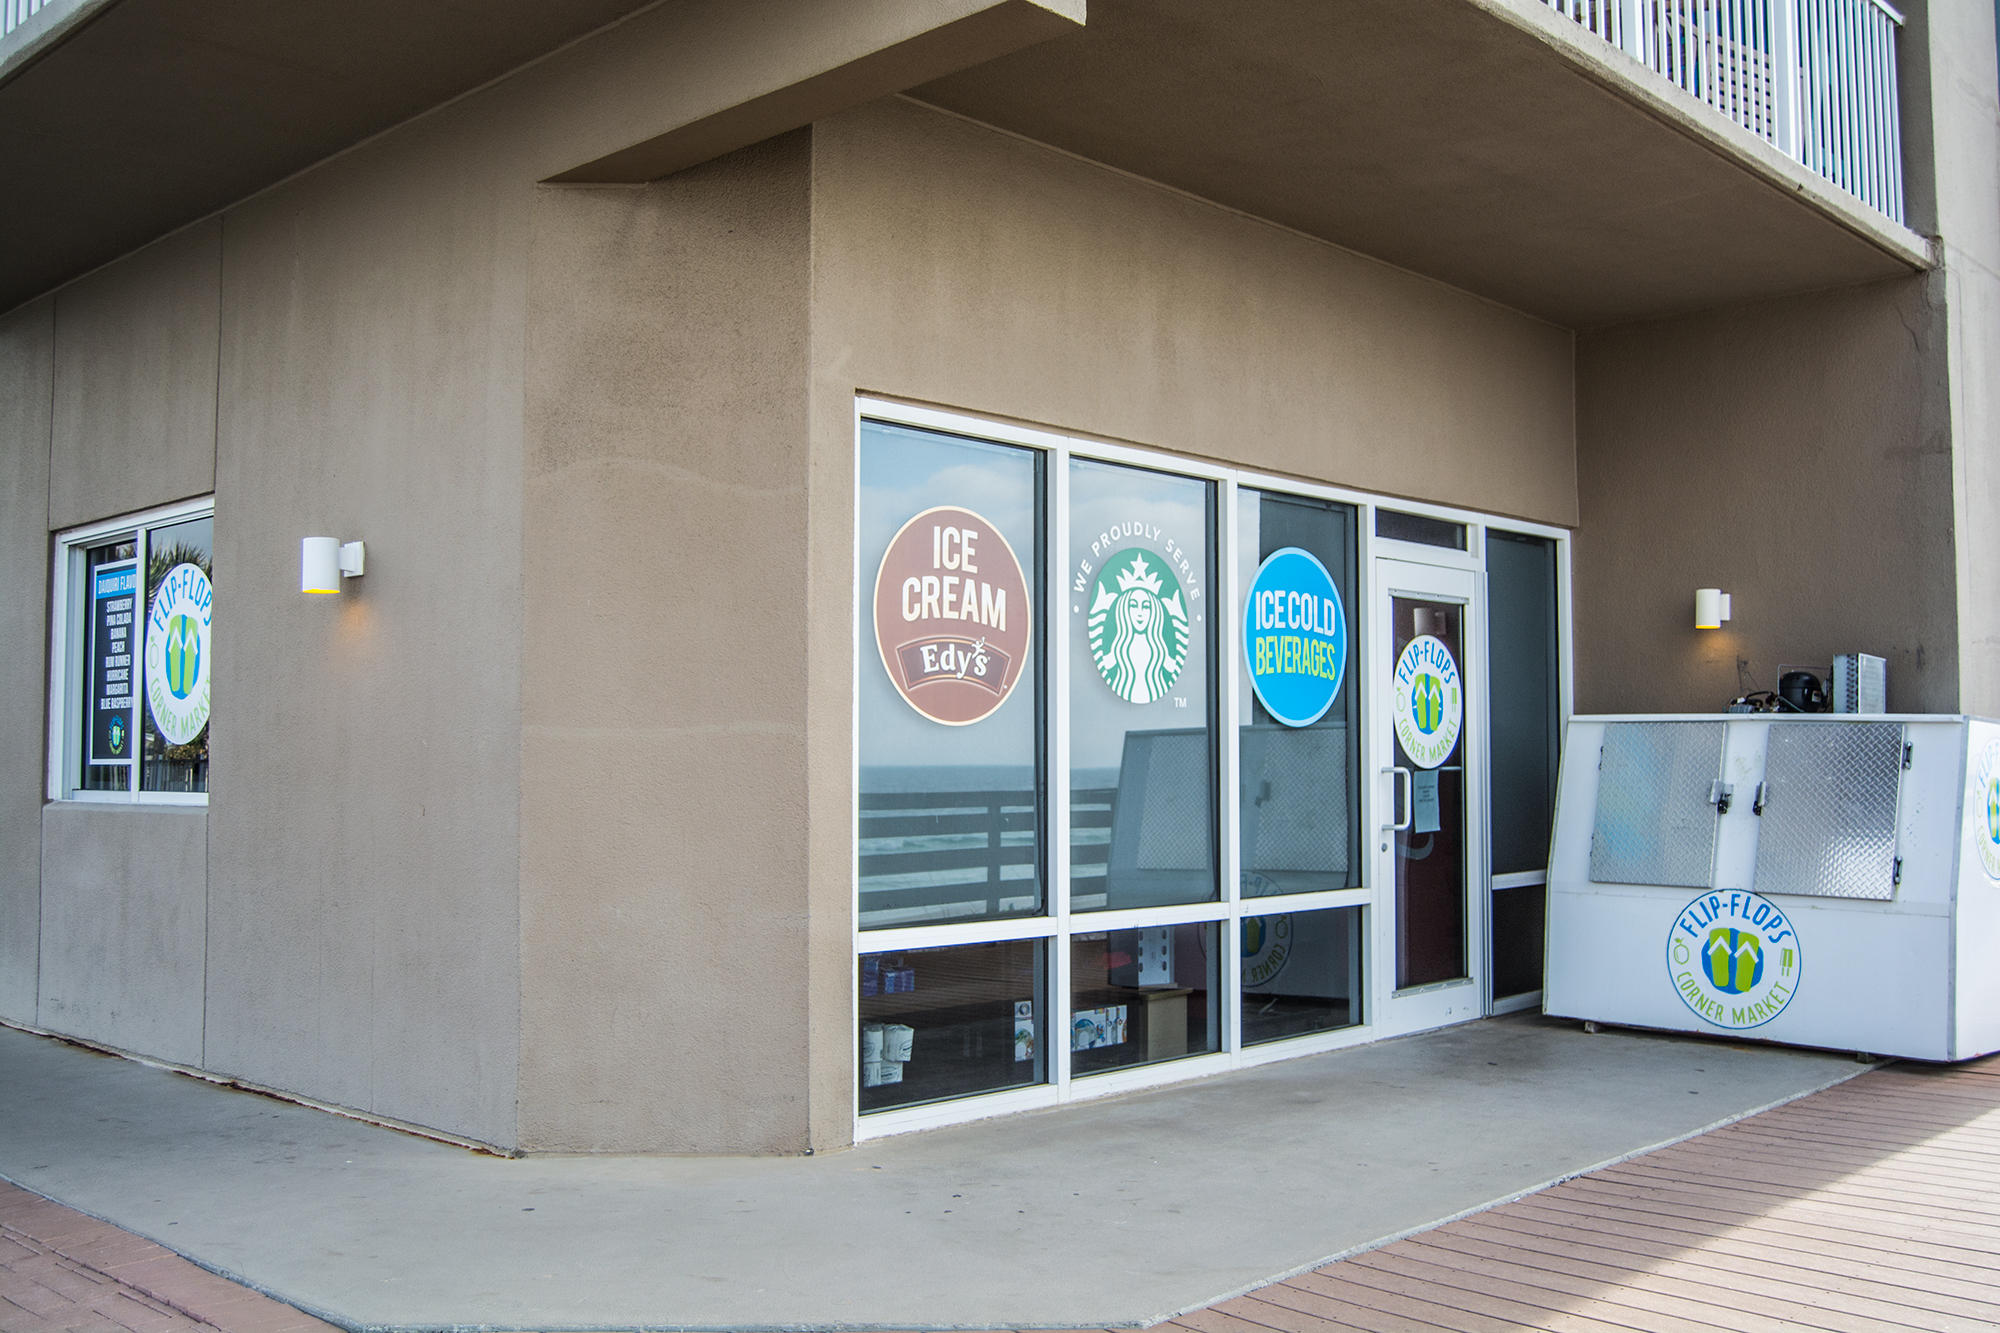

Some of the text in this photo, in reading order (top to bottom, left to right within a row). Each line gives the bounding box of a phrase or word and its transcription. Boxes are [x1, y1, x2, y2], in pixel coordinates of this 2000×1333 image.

[933, 526, 979, 574] ICE
[1073, 521, 1200, 600] WE PROUDLY SERVE
[902, 575, 1007, 632] CREAM
[1255, 590, 1336, 637] ICE COLD
[1255, 635, 1336, 681] BEVERAGES
[1398, 641, 1456, 685] FLIP-FLOPS
[151, 677, 177, 737] CORNER
[1174, 697, 1188, 709] TM
[1399, 718, 1457, 762] CORNER MARKET
[1679, 893, 1792, 944] FLIP-FLOPS
[1677, 971, 1791, 1025] CORNER MARKET
